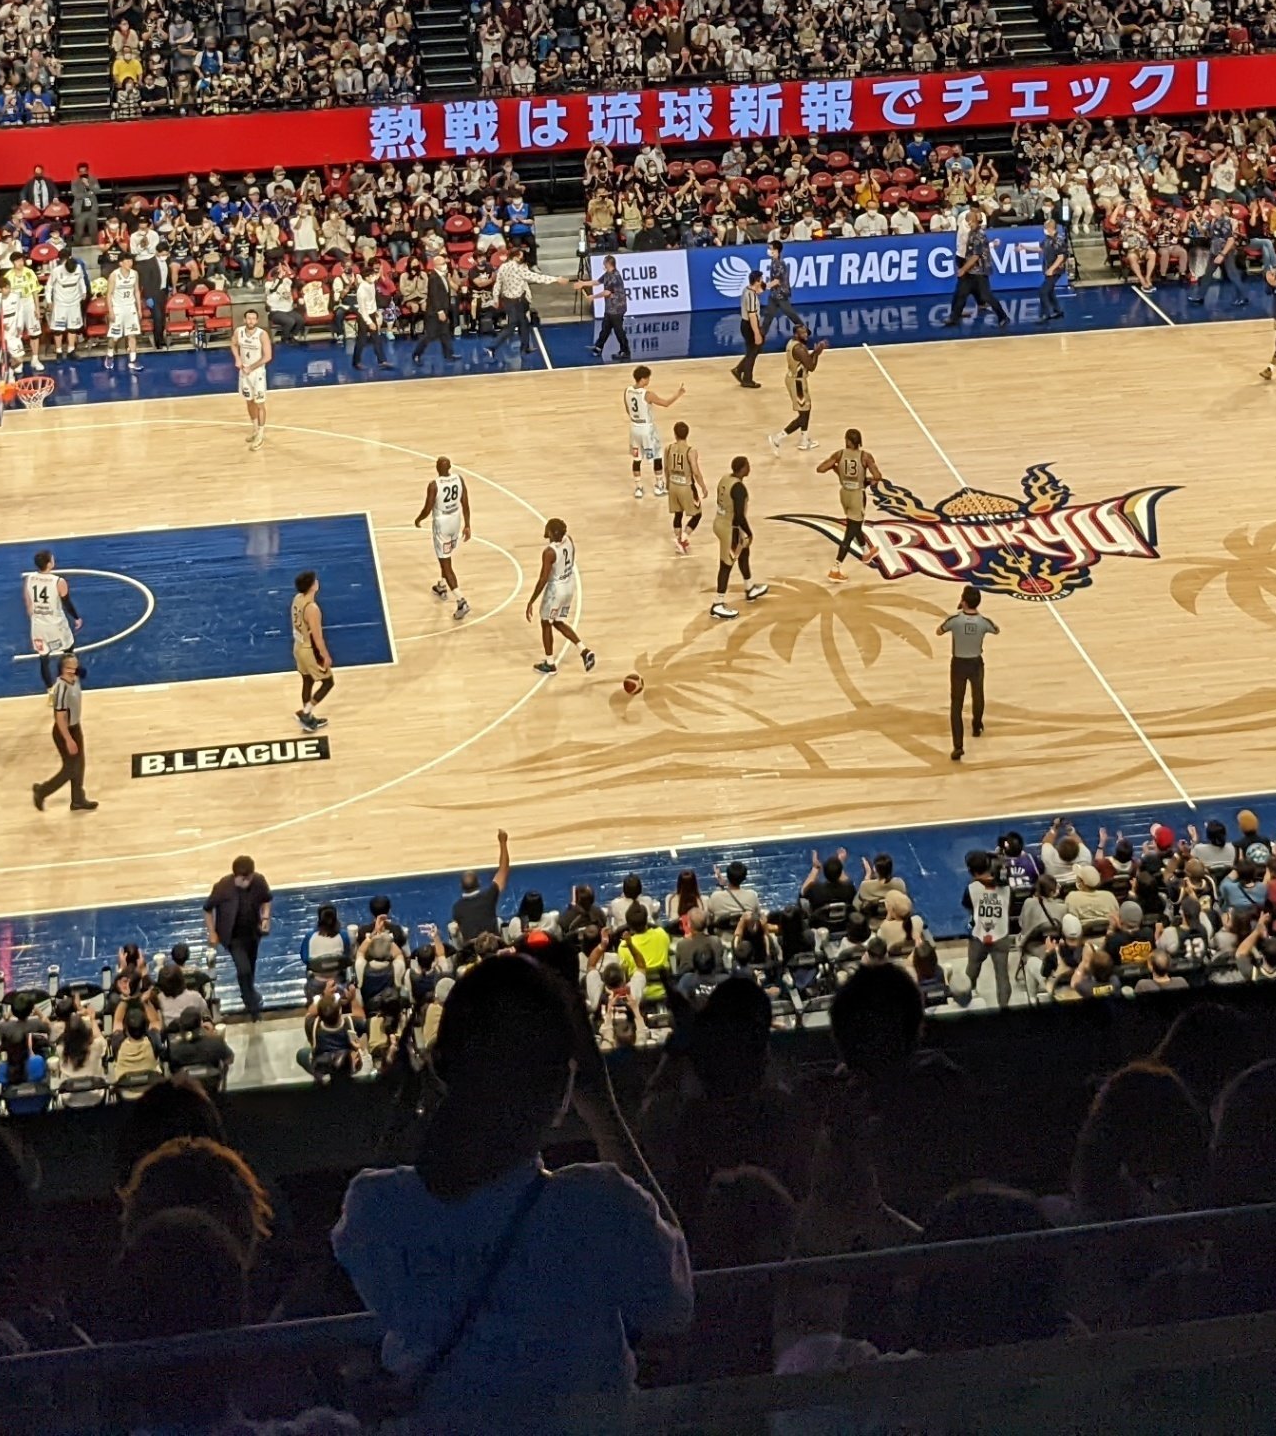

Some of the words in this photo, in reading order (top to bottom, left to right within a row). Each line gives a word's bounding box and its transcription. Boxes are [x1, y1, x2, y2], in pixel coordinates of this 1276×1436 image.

[838, 249, 920, 285] RACE
[927, 241, 1043, 279] GME
[621, 265, 658, 282] CLUB
[631, 397, 639, 413] 3
[673, 453, 684, 470] 14
[844, 459, 858, 476] 13
[442, 485, 459, 503] 28
[949, 512, 1026, 525] KINGS
[869, 500, 1149, 581] RYUKYU
[562, 548, 571, 567] 2
[32, 584, 50, 604] 14
[140, 739, 321, 775] B.LEAGUE
[978, 905, 1002, 918] 003
